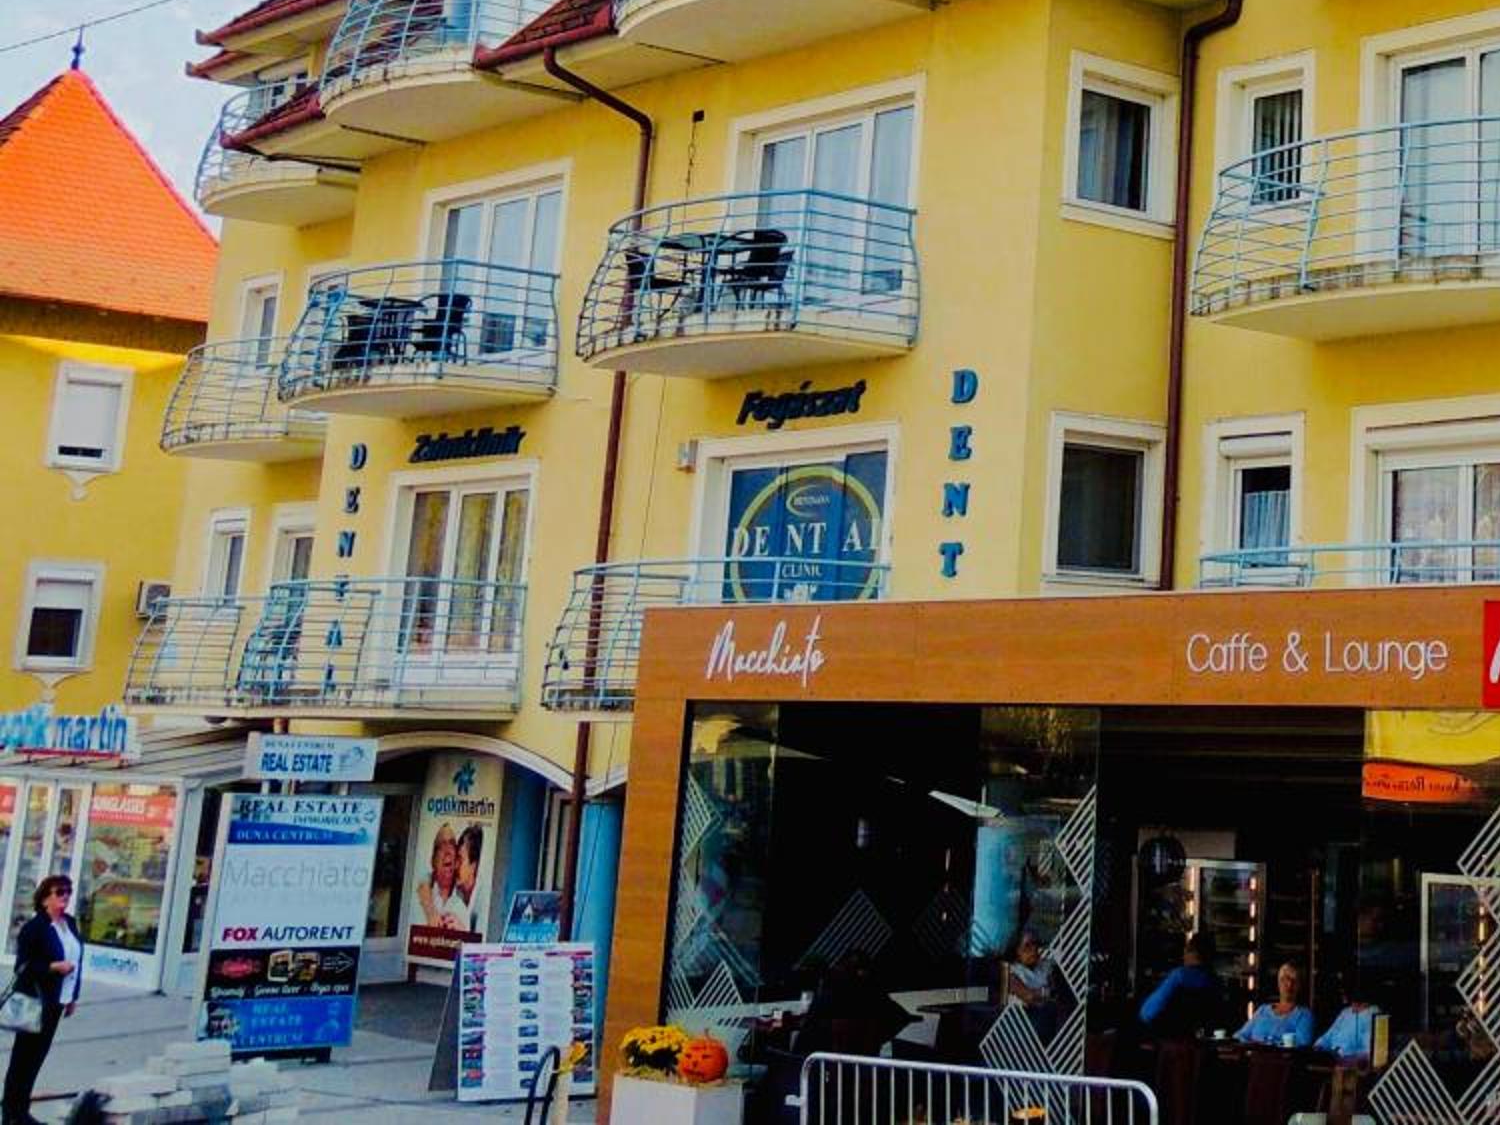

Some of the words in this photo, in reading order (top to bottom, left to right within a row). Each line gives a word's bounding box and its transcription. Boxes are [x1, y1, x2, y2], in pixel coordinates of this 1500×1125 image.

[782, 563, 823, 577] CLINIC
[706, 613, 825, 688] Macchiato
[1187, 633, 1268, 673] Caffe
[1283, 632, 1309, 672] &
[1325, 632, 1449, 679] Lounge
[261, 752, 289, 772] REAL
[291, 754, 333, 773] ESTATE
[239, 799, 287, 813] REAL
[293, 800, 363, 815] ESTATE
[427, 796, 495, 816] optikmartin
[222, 858, 369, 888] Macchiato
[222, 928, 258, 942] FOX
[261, 926, 355, 941] AUTORENT
